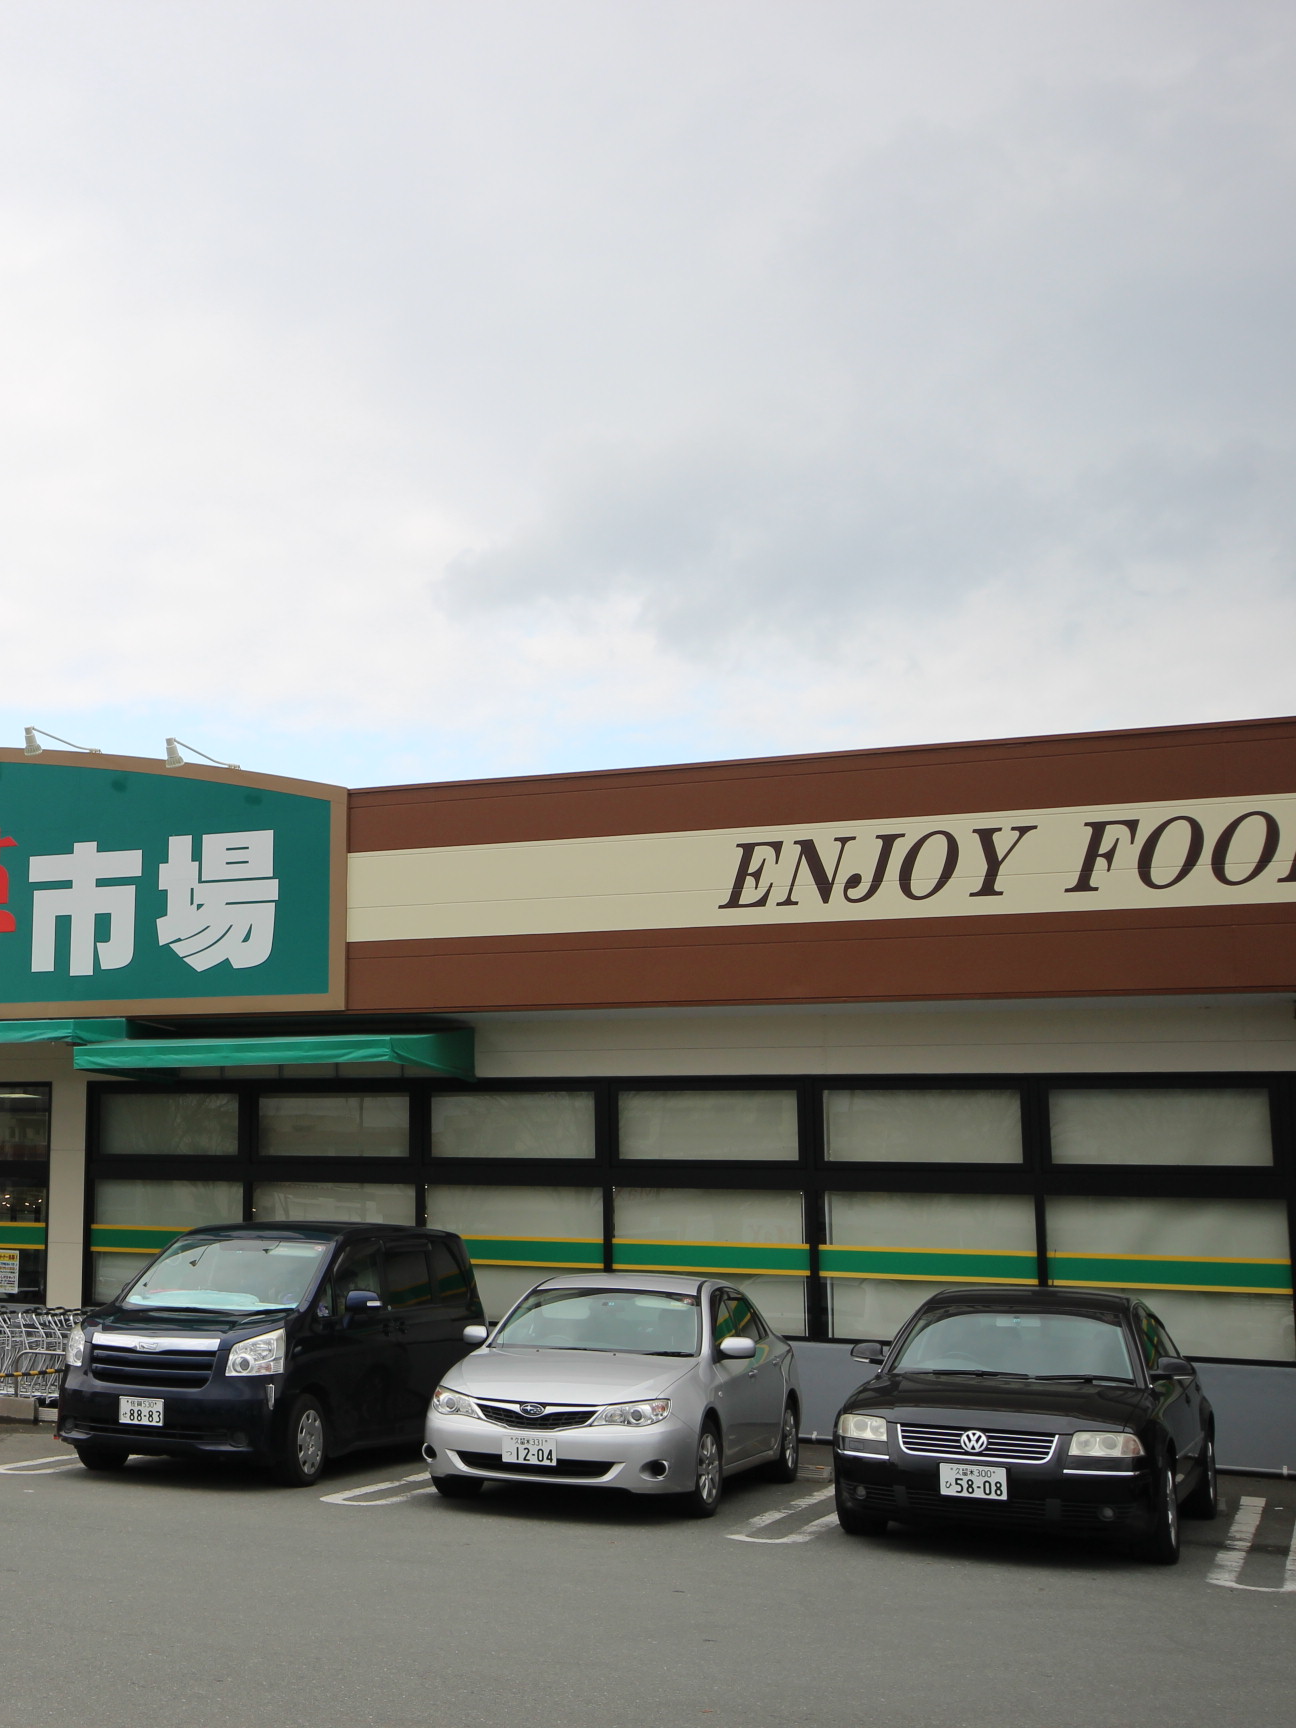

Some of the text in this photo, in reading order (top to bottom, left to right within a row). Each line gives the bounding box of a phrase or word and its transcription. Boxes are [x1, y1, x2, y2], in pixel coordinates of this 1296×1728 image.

[717, 810, 1296, 910] ENJOY FOO
[129, 1409, 161, 1423] 88-83
[516, 1447, 553, 1463] 12-04
[955, 1478, 1003, 1497] 58-08
